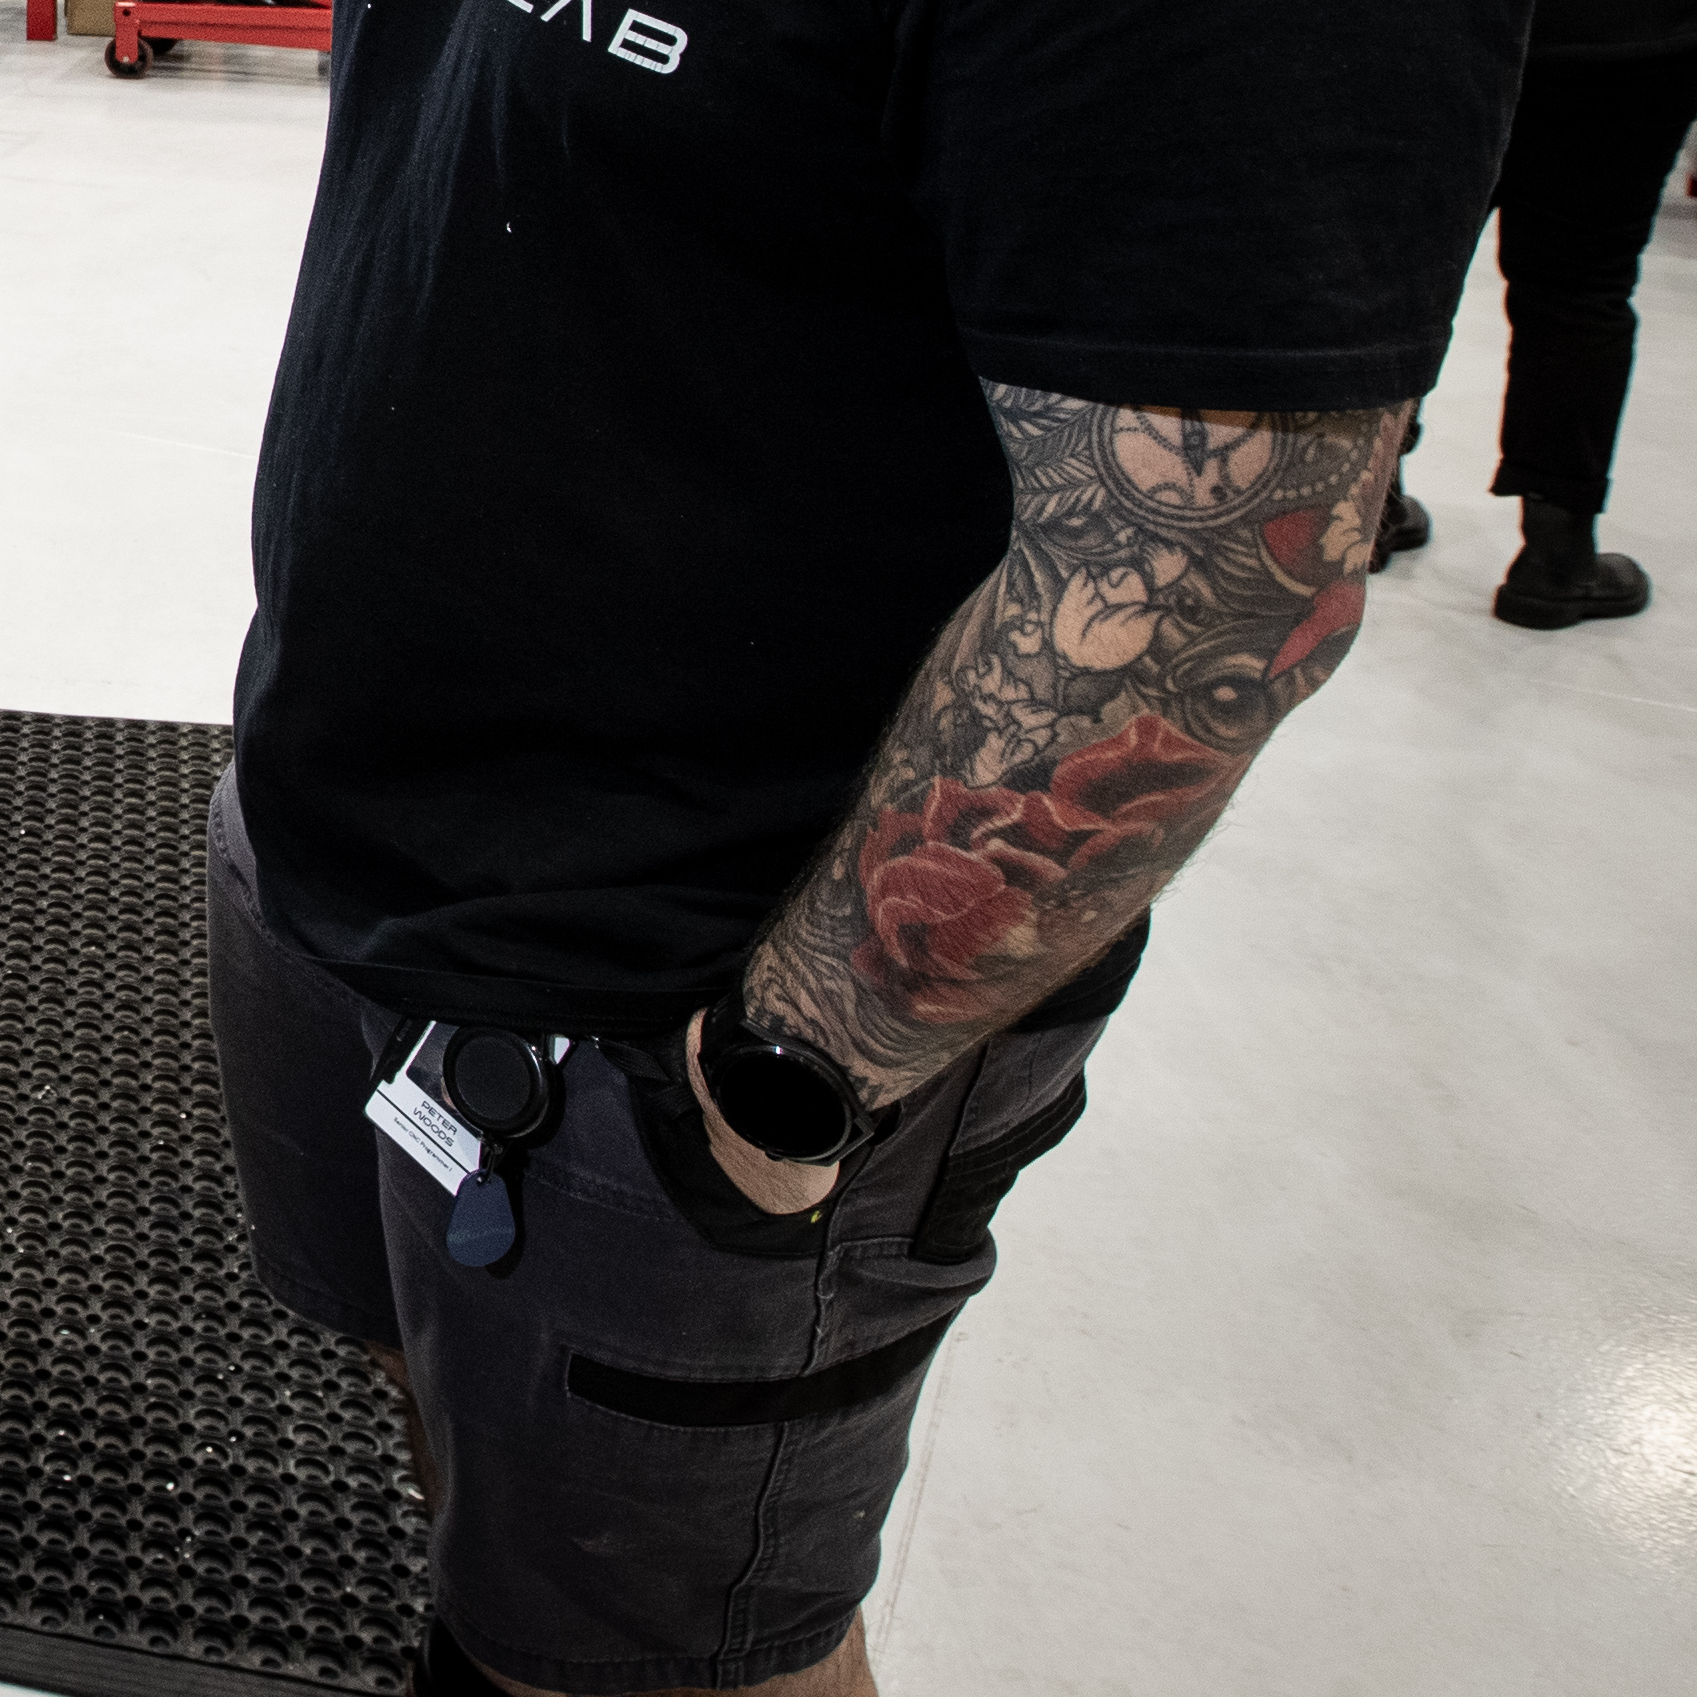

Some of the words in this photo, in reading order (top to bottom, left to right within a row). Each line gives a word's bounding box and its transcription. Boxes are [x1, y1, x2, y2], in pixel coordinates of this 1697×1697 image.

[413, 1107, 455, 1147] WOODS
[421, 1100, 458, 1136] PETER
[393, 1116, 409, 1133] Senior
[408, 1130, 421, 1144] CNC
[420, 1140, 449, 1169] Programmer
